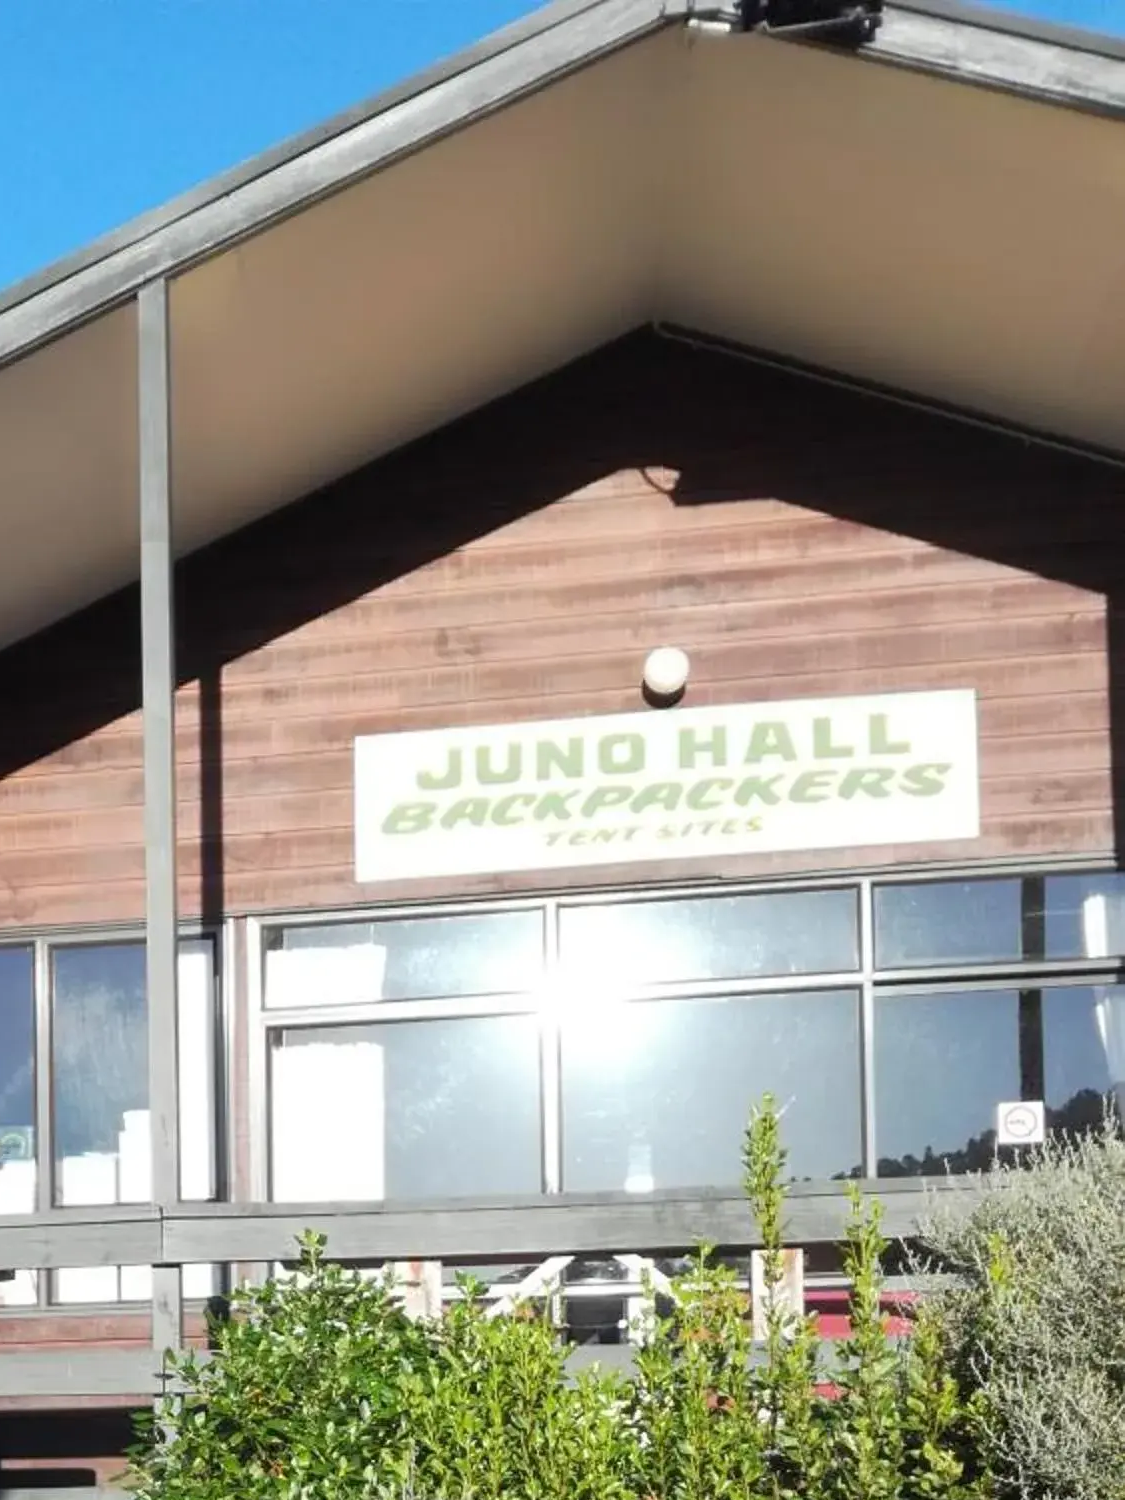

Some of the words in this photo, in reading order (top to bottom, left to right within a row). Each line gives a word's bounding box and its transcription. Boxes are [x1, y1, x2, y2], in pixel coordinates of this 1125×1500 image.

[416, 733, 646, 790] JUNO
[679, 713, 911, 769] HALL
[382, 762, 952, 835] BACKPACKERS
[544, 825, 639, 847] TENT
[656, 815, 764, 840] SITES
